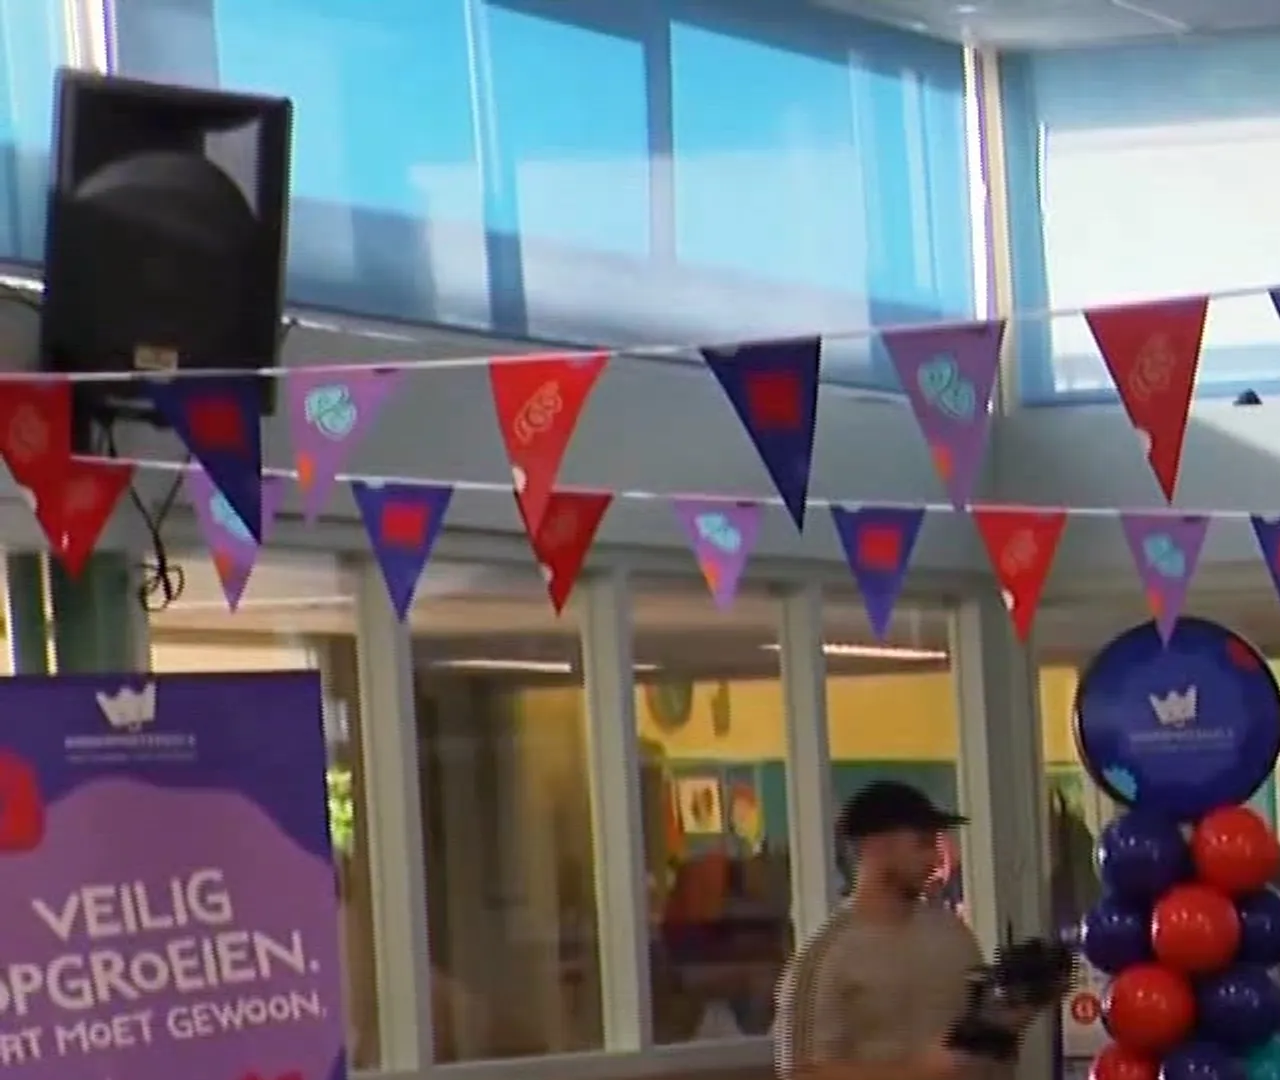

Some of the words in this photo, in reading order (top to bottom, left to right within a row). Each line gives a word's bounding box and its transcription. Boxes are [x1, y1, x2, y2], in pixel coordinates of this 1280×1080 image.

[31, 868, 234, 942] VEILIG
[0, 929, 321, 1017] PGROEIEN.
[0, 1025, 43, 1068] AT
[53, 1009, 153, 1057] MOET
